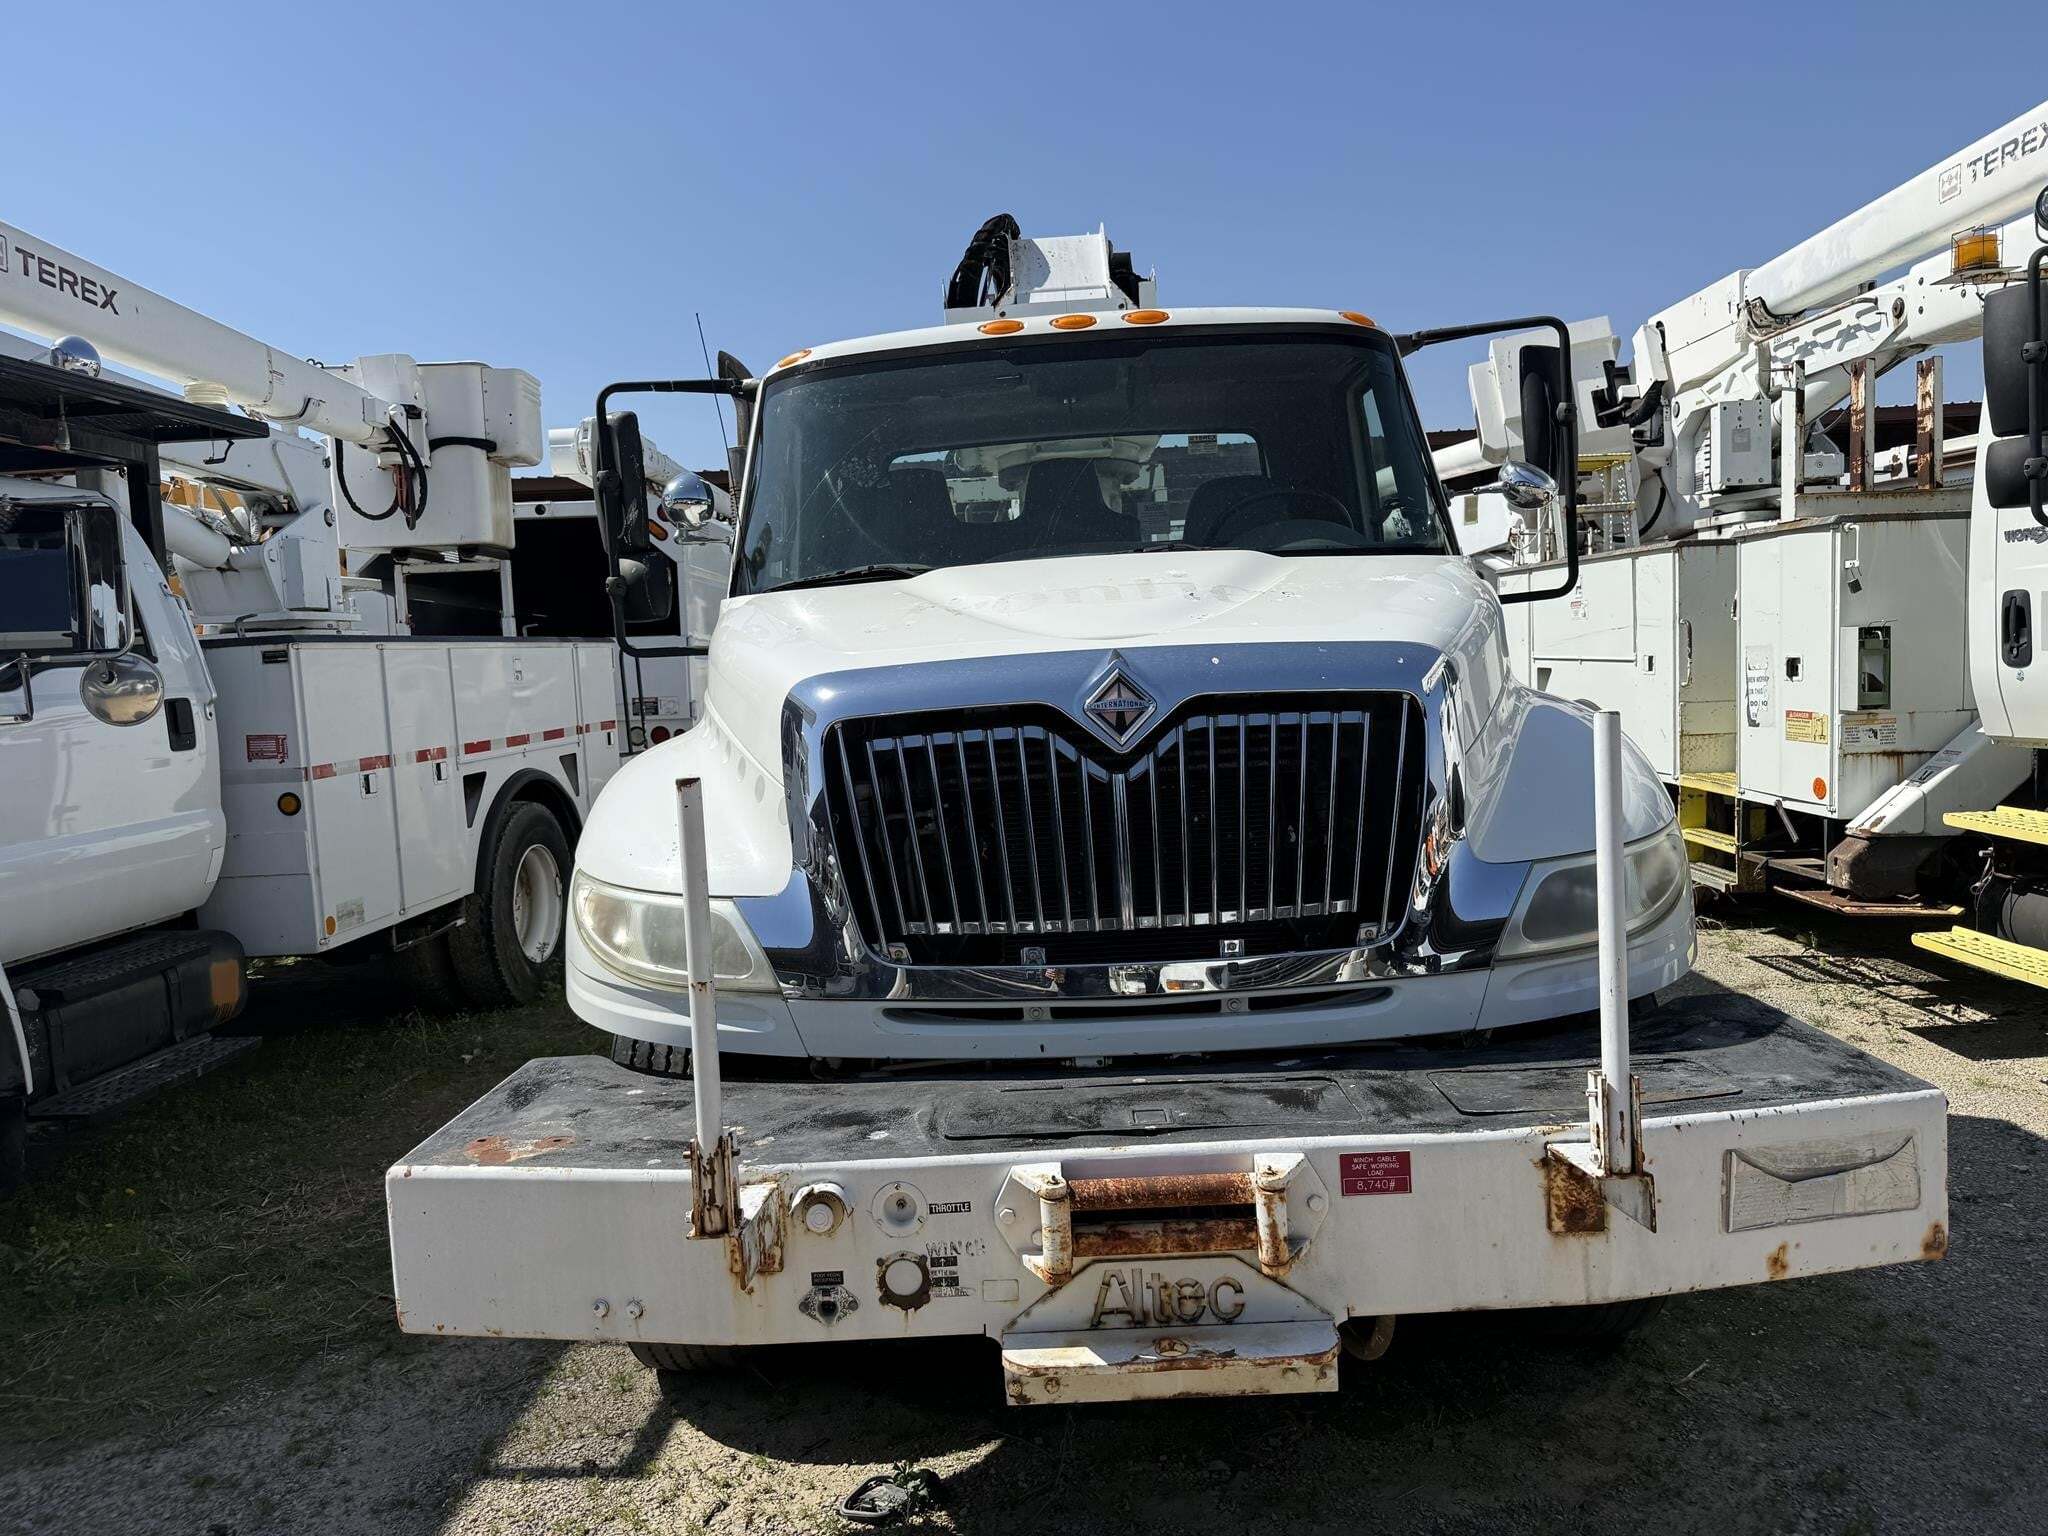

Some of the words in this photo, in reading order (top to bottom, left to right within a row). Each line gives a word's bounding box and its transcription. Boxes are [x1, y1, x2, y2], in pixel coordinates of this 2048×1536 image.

[15, 246, 119, 315] TEREX
[932, 1203, 970, 1213] THROTTLE
[1091, 1268, 1246, 1329] Altec
